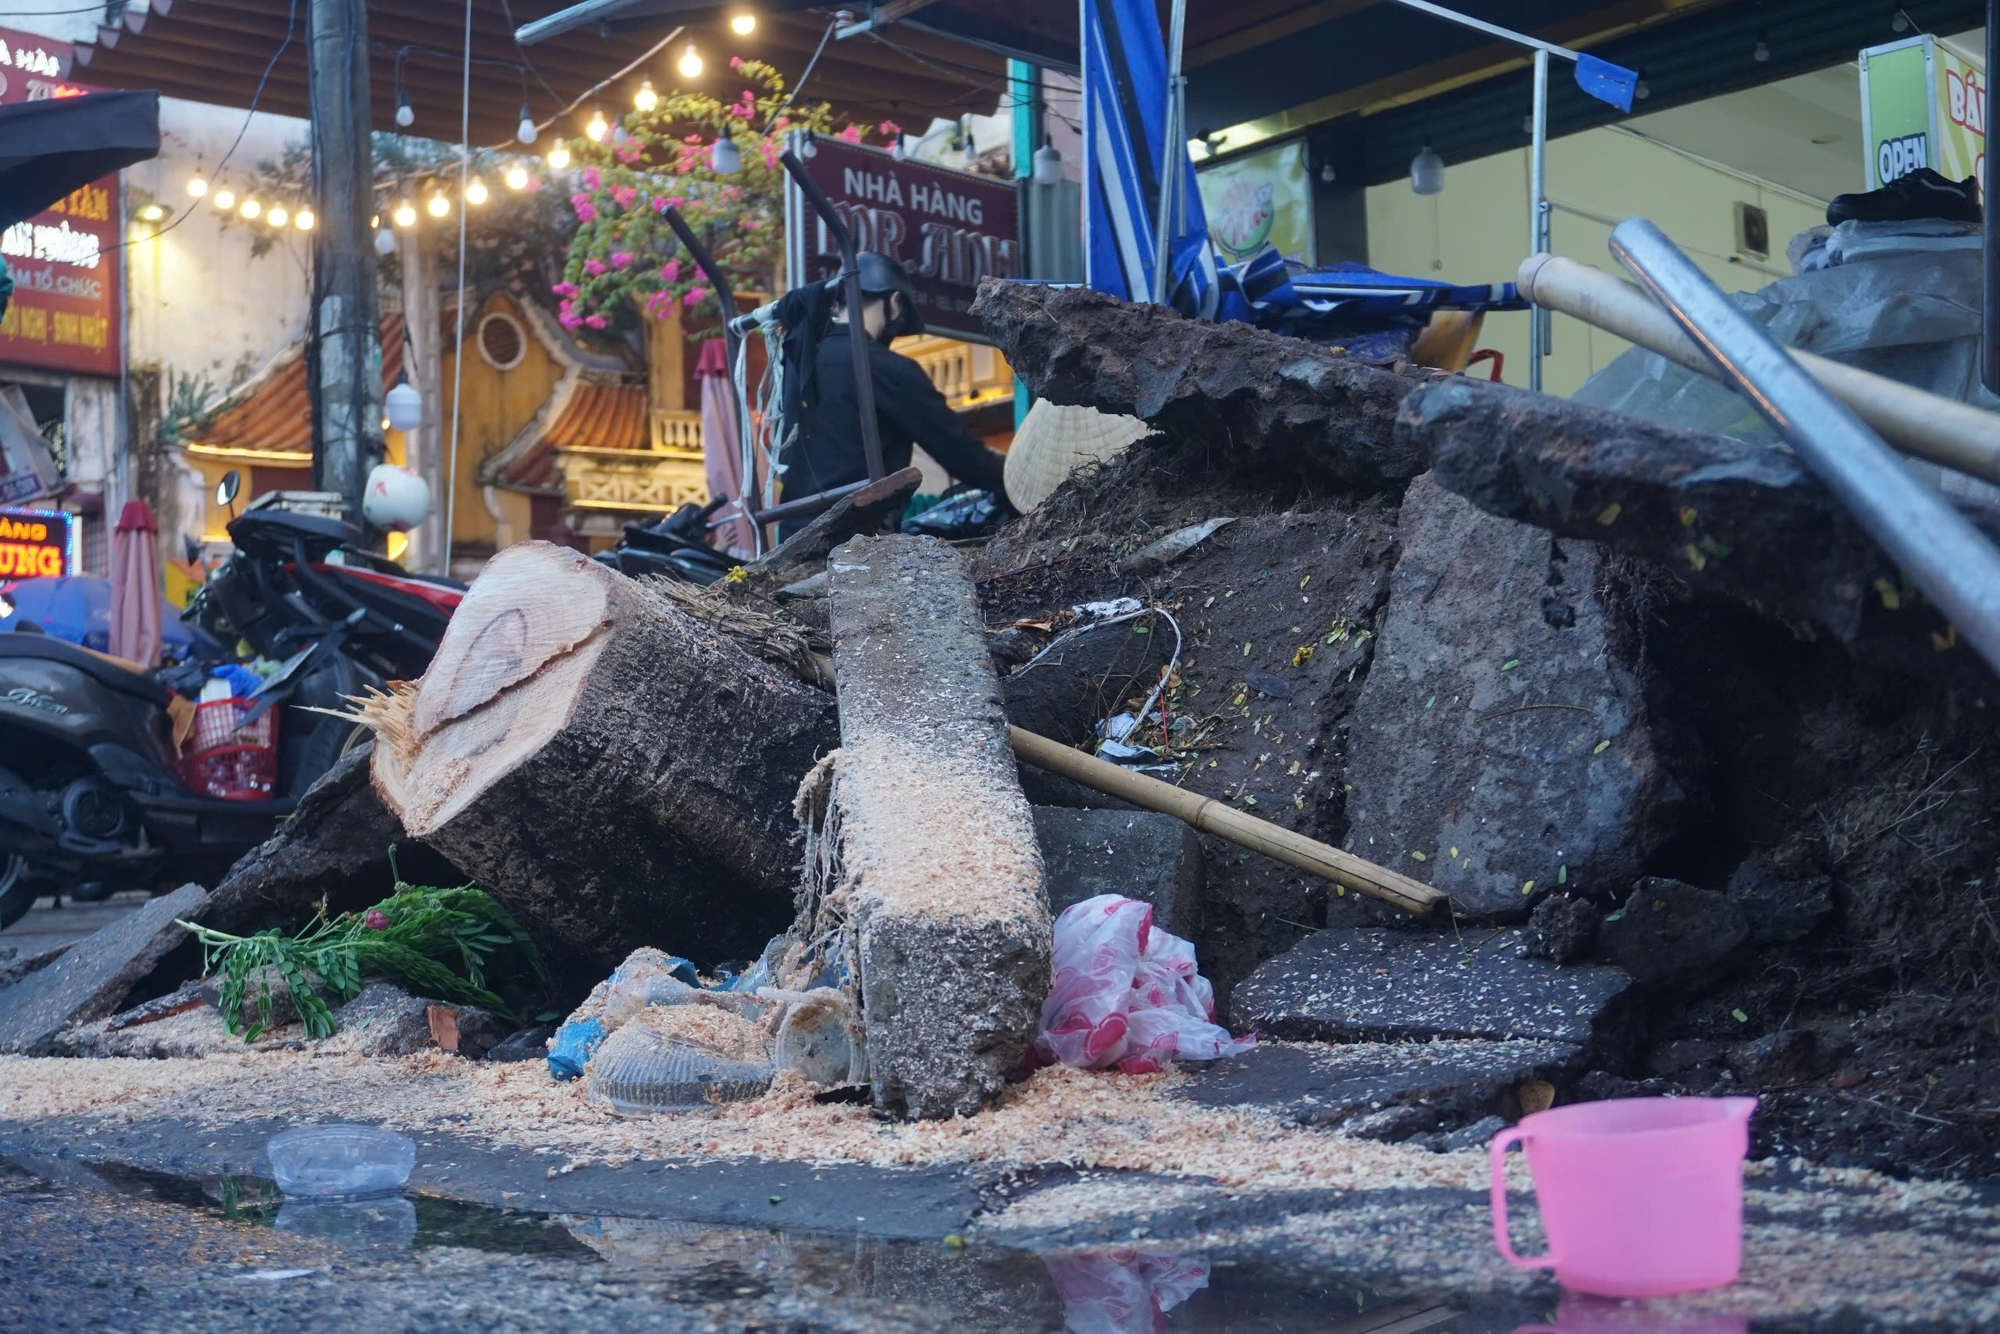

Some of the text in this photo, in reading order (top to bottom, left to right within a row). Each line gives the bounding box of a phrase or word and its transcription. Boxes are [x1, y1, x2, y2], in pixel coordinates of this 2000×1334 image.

[1946, 69, 1986, 138] BÁ
[1879, 131, 1928, 187] OPEN
[843, 167, 984, 226] NHÀ HÀNG
[0, 542, 62, 578] UNG
